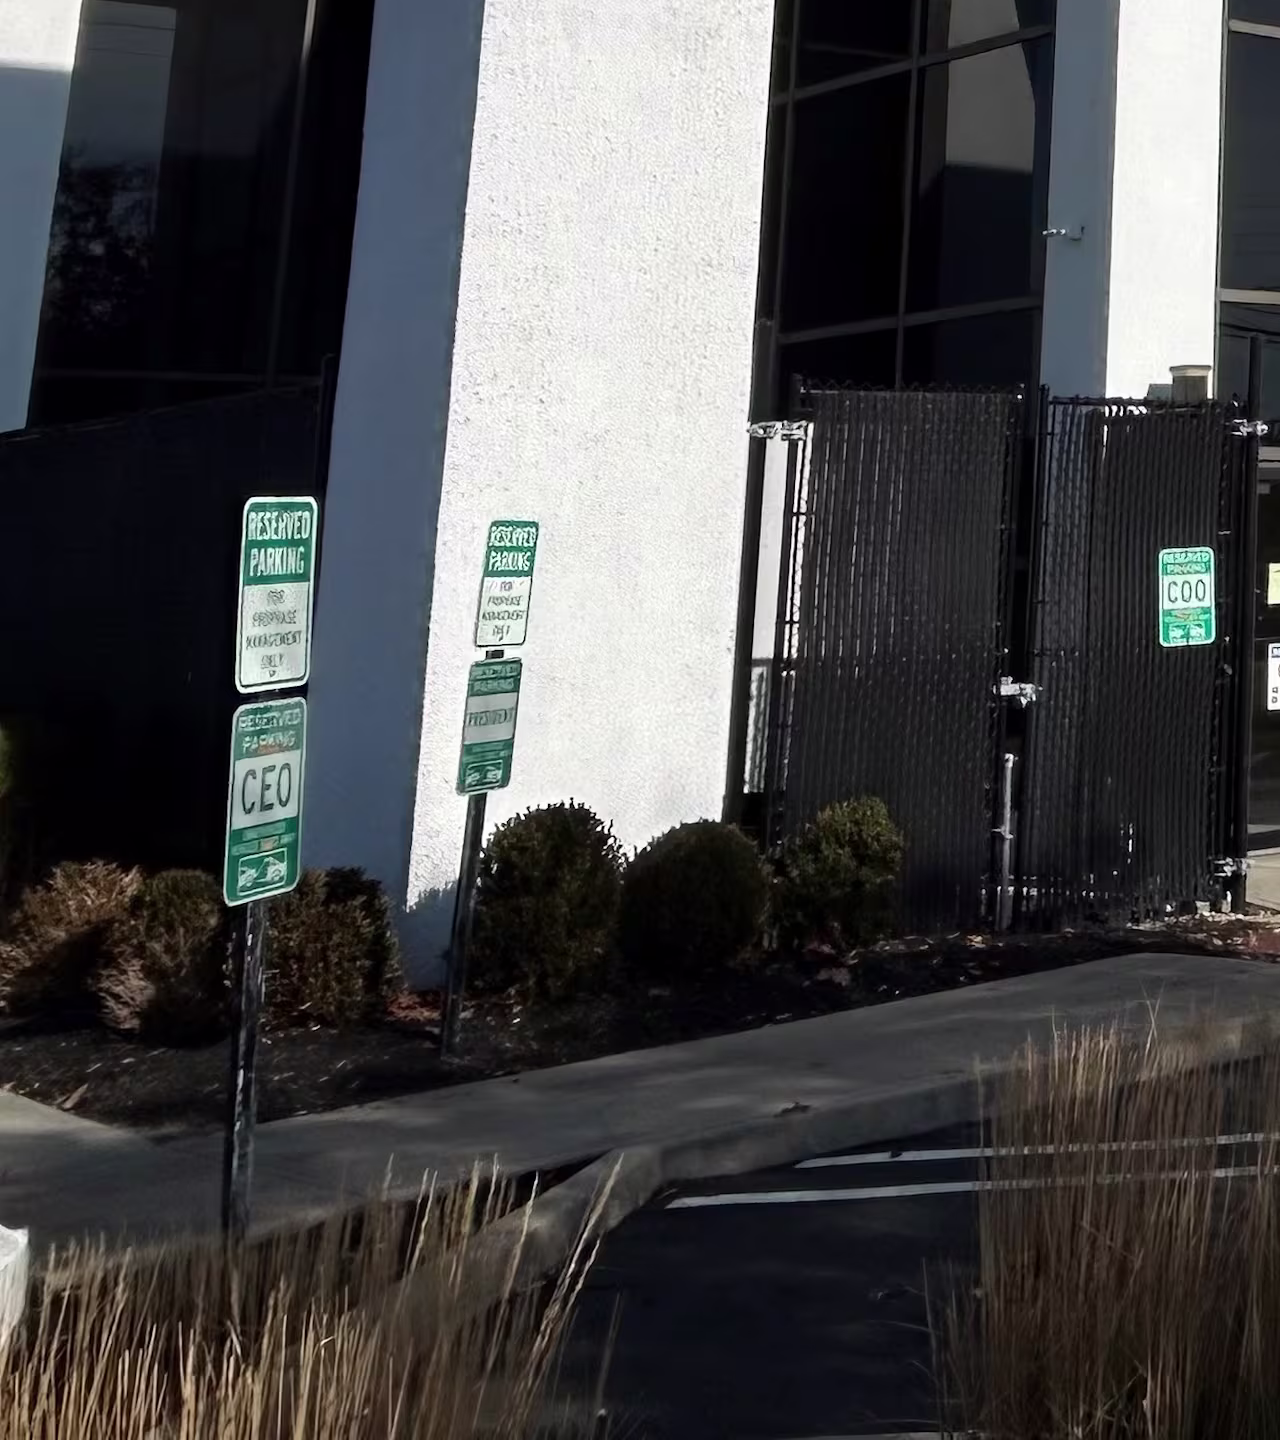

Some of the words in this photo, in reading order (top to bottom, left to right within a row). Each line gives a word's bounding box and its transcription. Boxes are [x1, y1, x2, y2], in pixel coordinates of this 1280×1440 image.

[248, 511, 311, 541] RESERVED
[250, 546, 305, 577] PARKING
[487, 550, 532, 572] PARKING
[1168, 579, 1206, 603] COO
[238, 708, 302, 732] RESERVED
[241, 730, 297, 753] PARKING
[241, 762, 293, 816] CEO
